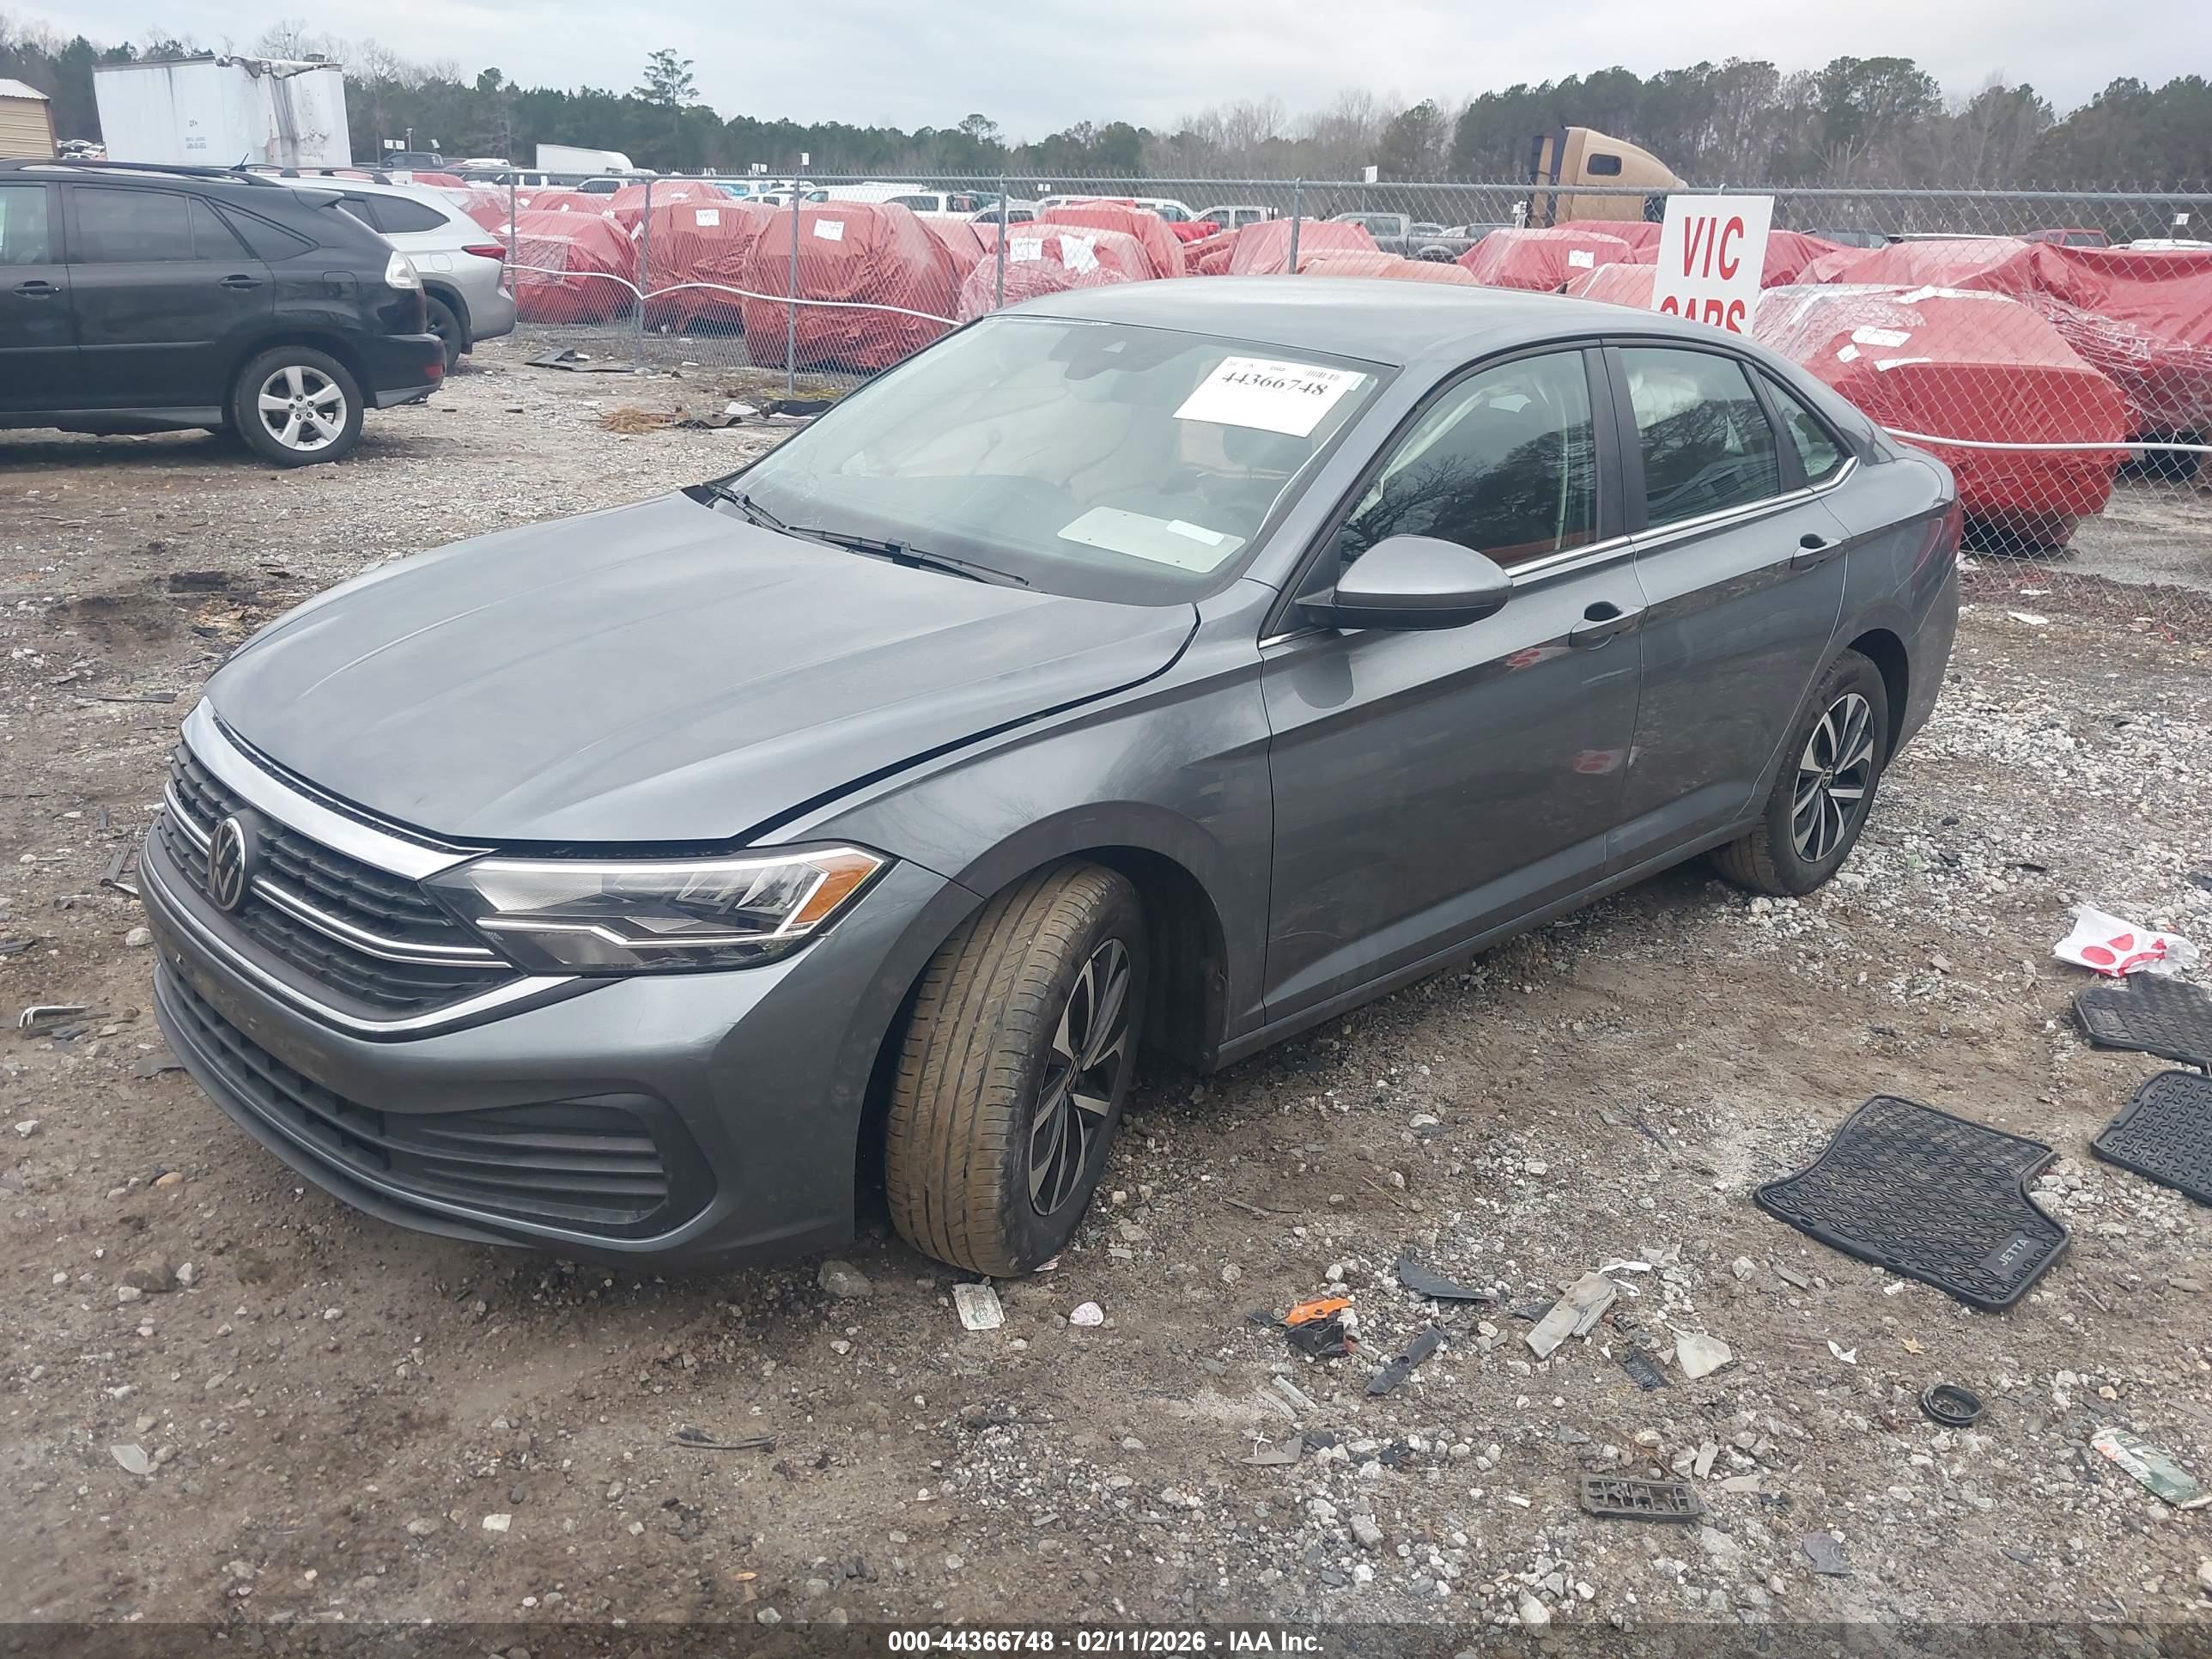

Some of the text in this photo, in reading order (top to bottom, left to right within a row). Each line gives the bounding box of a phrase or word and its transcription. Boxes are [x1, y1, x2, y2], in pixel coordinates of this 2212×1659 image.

[1683, 216, 1744, 281] VIC
[1221, 371, 1329, 397] 44366748
[1998, 1238, 2031, 1267] JETTA
